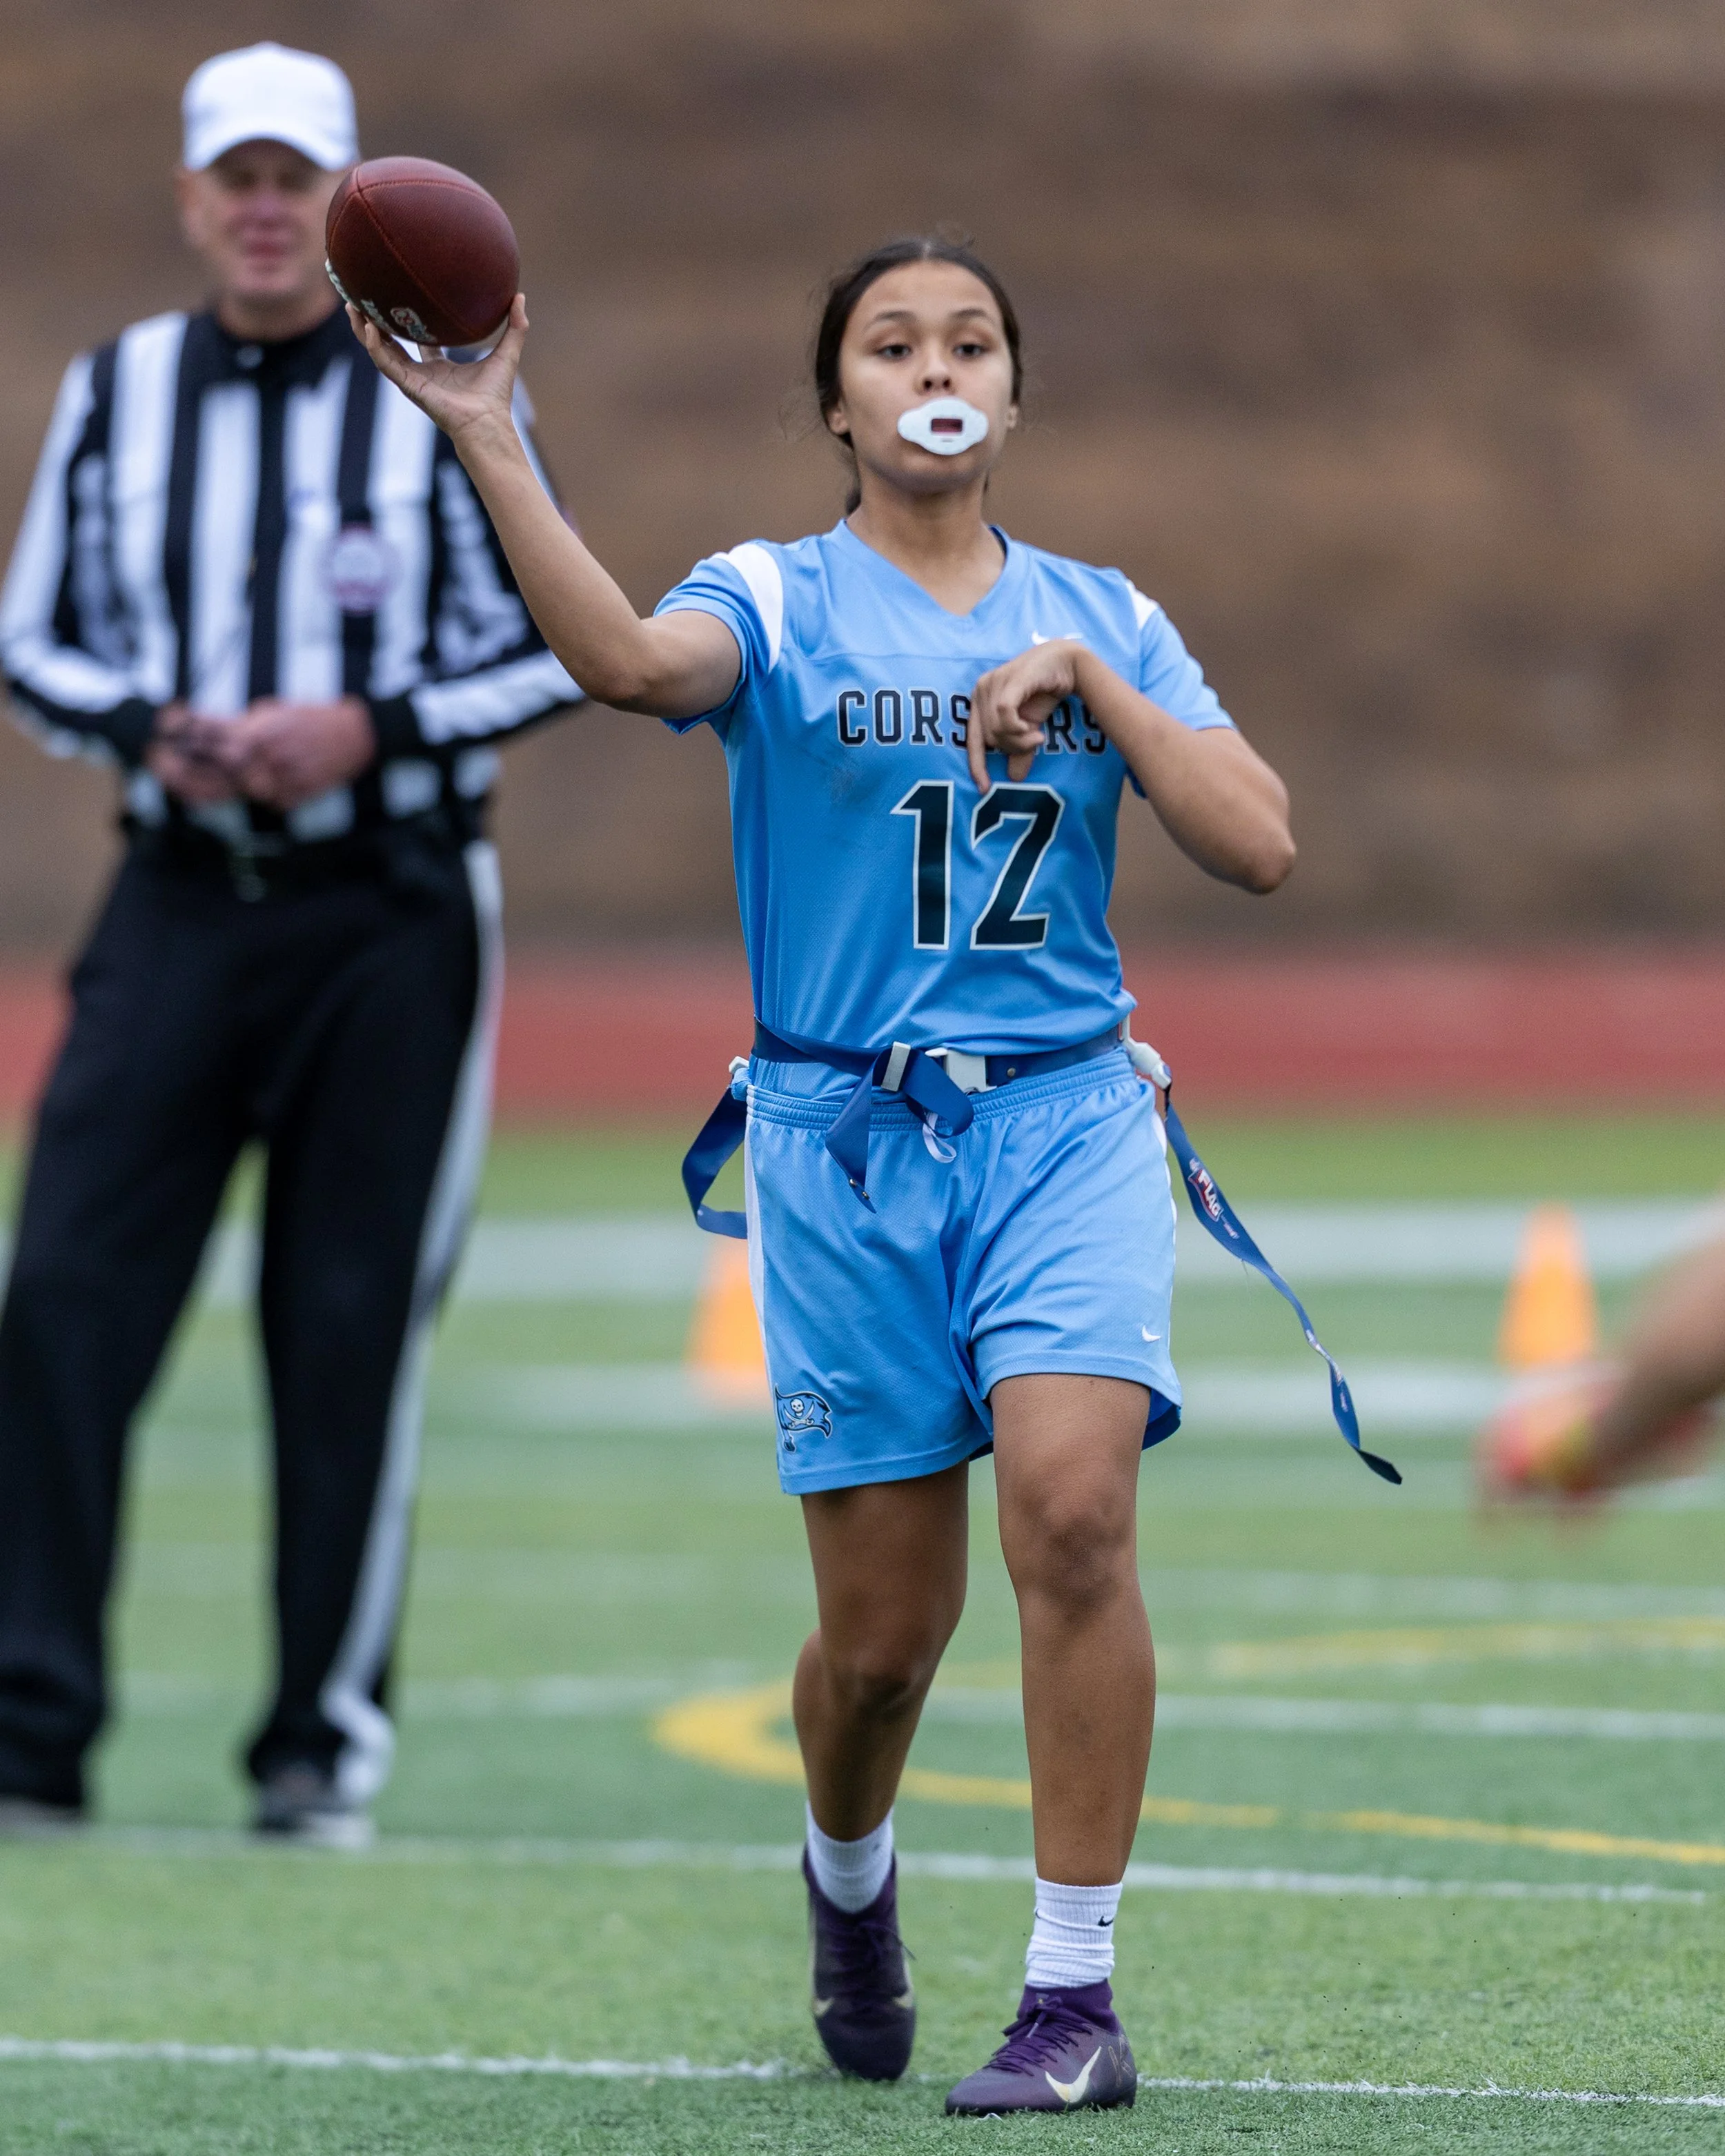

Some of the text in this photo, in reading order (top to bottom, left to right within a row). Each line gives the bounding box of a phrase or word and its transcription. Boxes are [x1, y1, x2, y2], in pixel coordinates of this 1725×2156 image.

[836, 685, 1110, 756] CORSRS
[890, 780, 1065, 951] 12
[1196, 1168, 1223, 1217] FLAG
